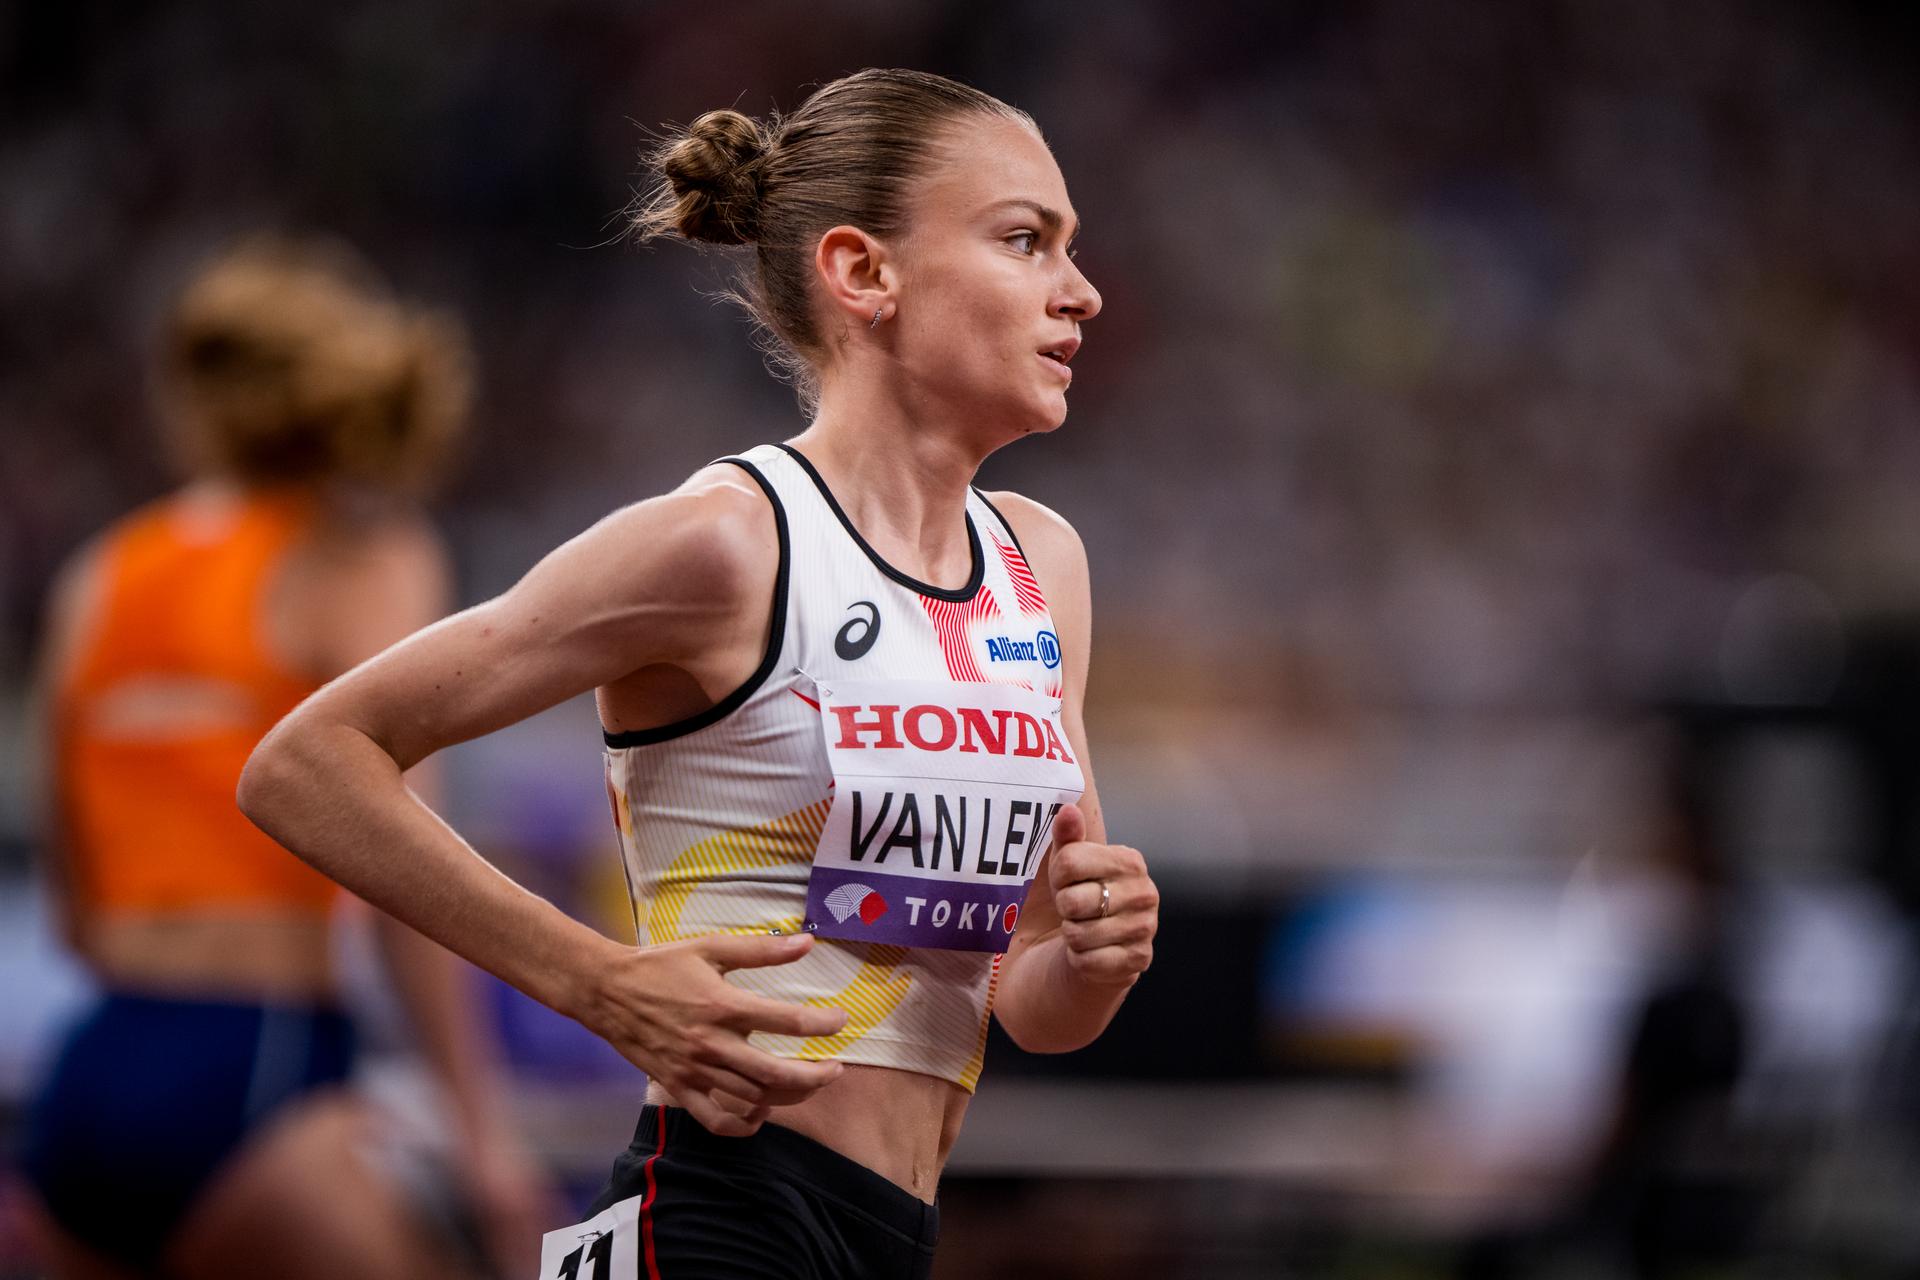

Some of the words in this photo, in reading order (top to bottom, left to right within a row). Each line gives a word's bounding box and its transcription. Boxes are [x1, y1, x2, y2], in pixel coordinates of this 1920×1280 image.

[985, 636, 1038, 662] Allianz
[829, 704, 1074, 764] HONDA
[850, 790, 966, 872] VAN
